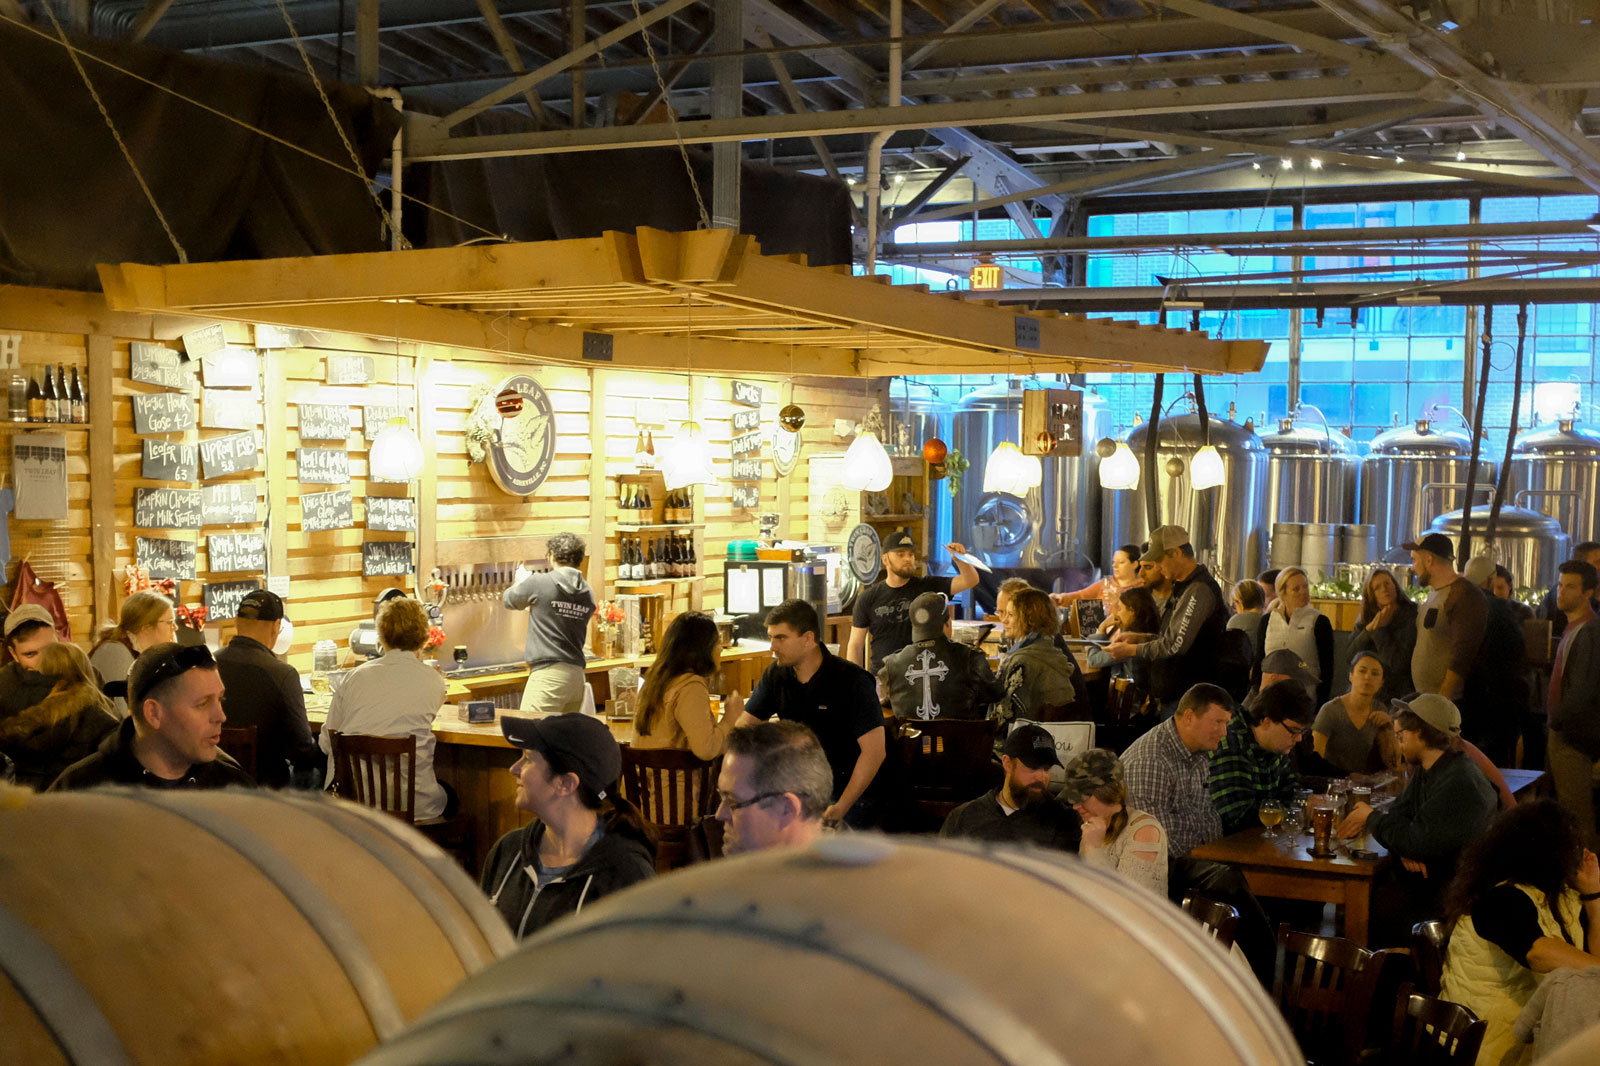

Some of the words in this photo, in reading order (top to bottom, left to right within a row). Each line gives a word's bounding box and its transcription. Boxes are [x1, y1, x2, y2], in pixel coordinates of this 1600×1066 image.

[974, 267, 999, 288] EXIT
[516, 383, 542, 400] LEAF
[551, 600, 573, 610] TWIN
[573, 603, 590, 614] LEAF
[1184, 595, 1197, 617] WAY
[1178, 616, 1191, 636] THE
